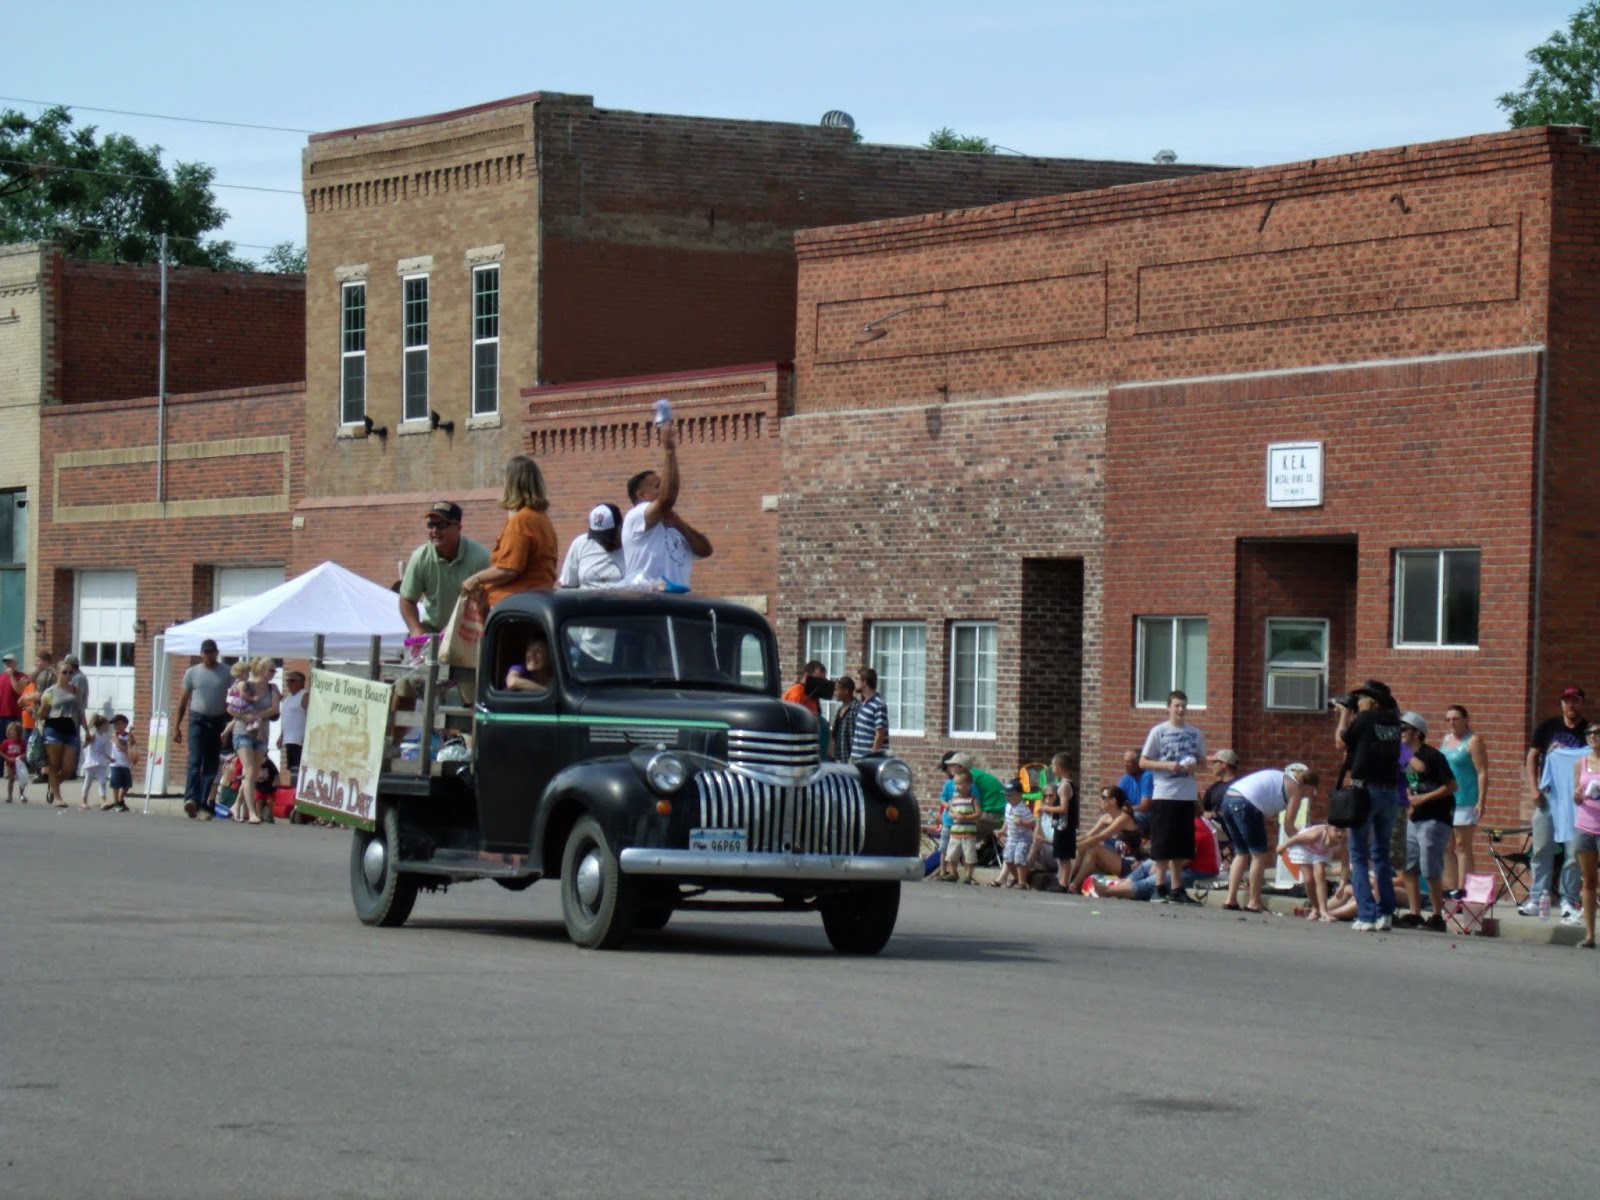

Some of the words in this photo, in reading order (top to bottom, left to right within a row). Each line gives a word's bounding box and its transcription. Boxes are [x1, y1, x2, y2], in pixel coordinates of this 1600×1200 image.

[334, 678, 341, 693] &
[343, 679, 362, 699] Town
[365, 684, 388, 704] Board
[298, 765, 344, 809] LaSalle
[346, 777, 373, 824] Day
